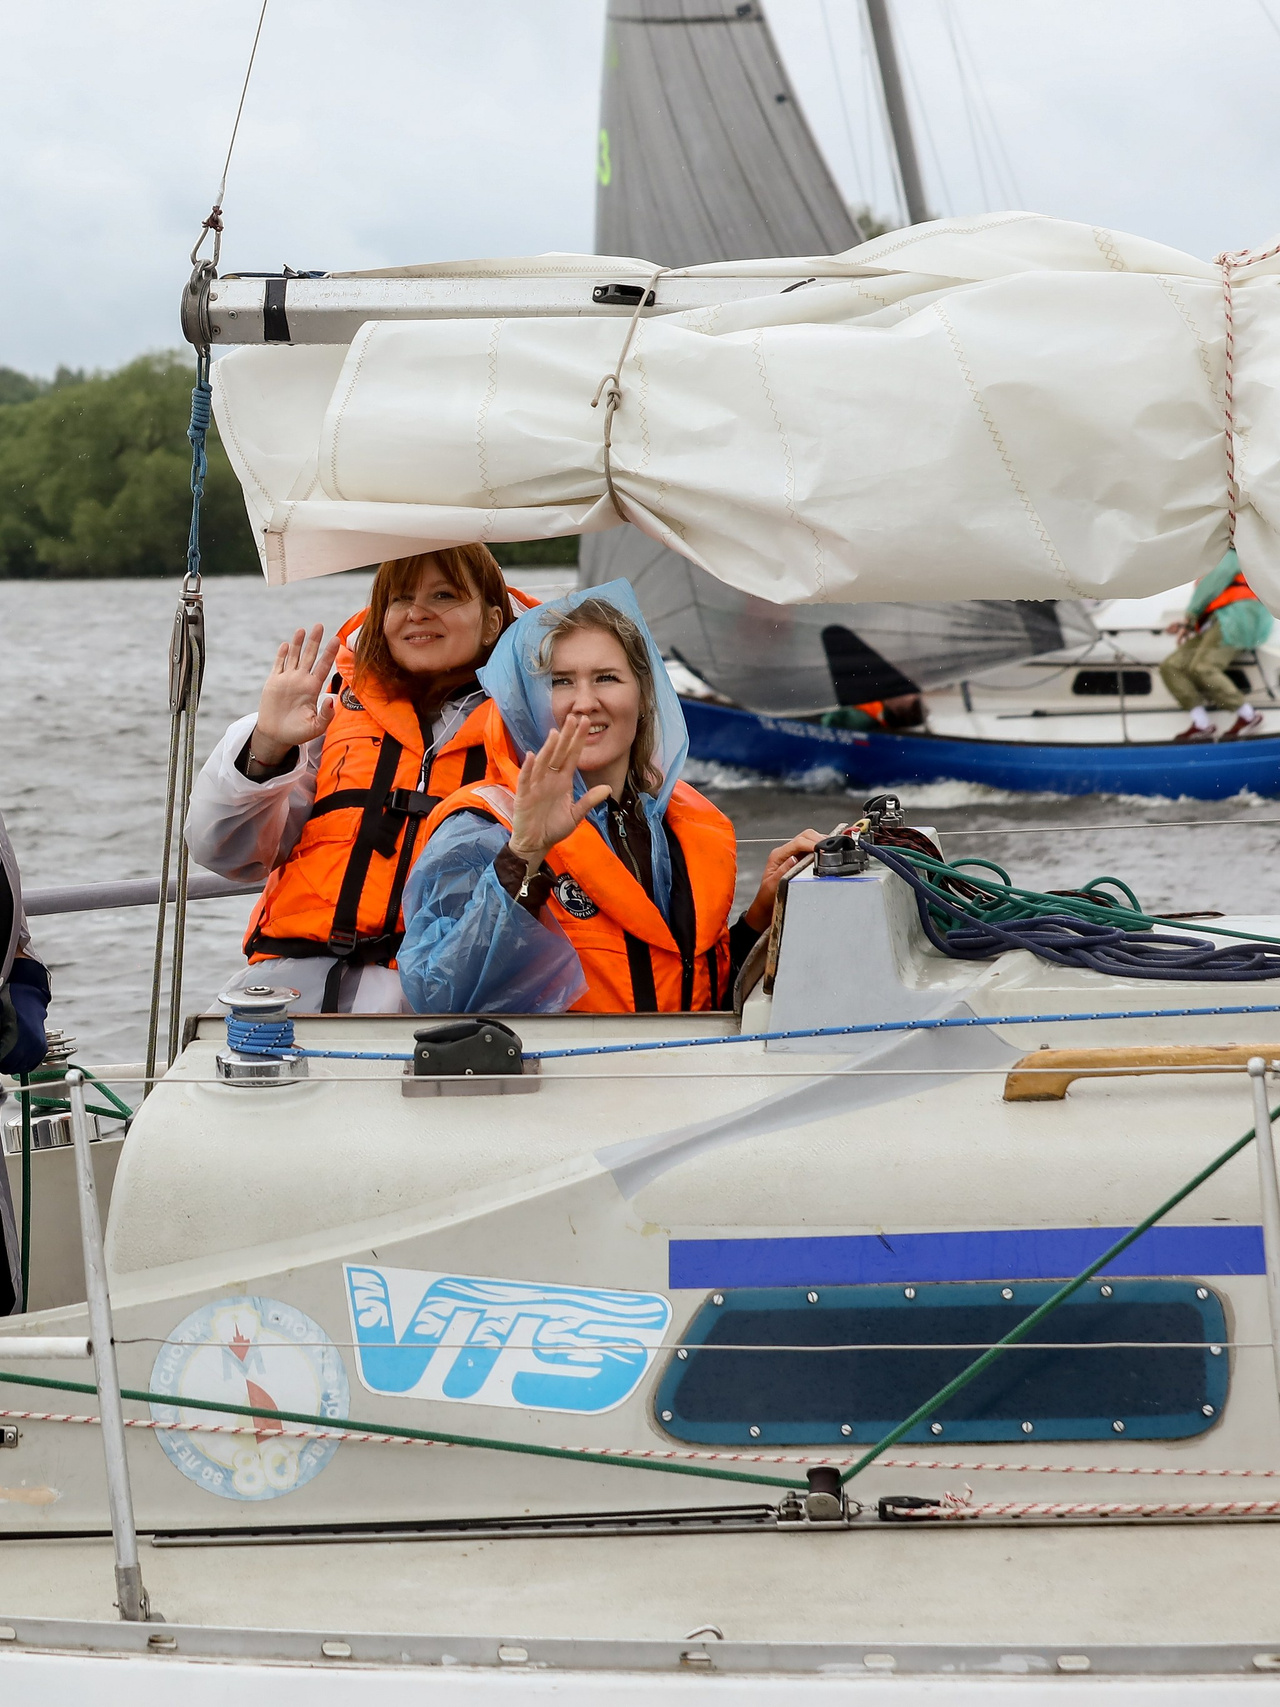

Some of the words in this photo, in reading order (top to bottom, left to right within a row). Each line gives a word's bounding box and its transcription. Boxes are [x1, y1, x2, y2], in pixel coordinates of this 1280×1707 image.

[158, 1321, 203, 1433] АУСНОМУ
[170, 1438, 200, 1470] ЛЕТ
[302, 1388, 341, 1467] МОВЕ
[233, 1444, 299, 1496] 80
